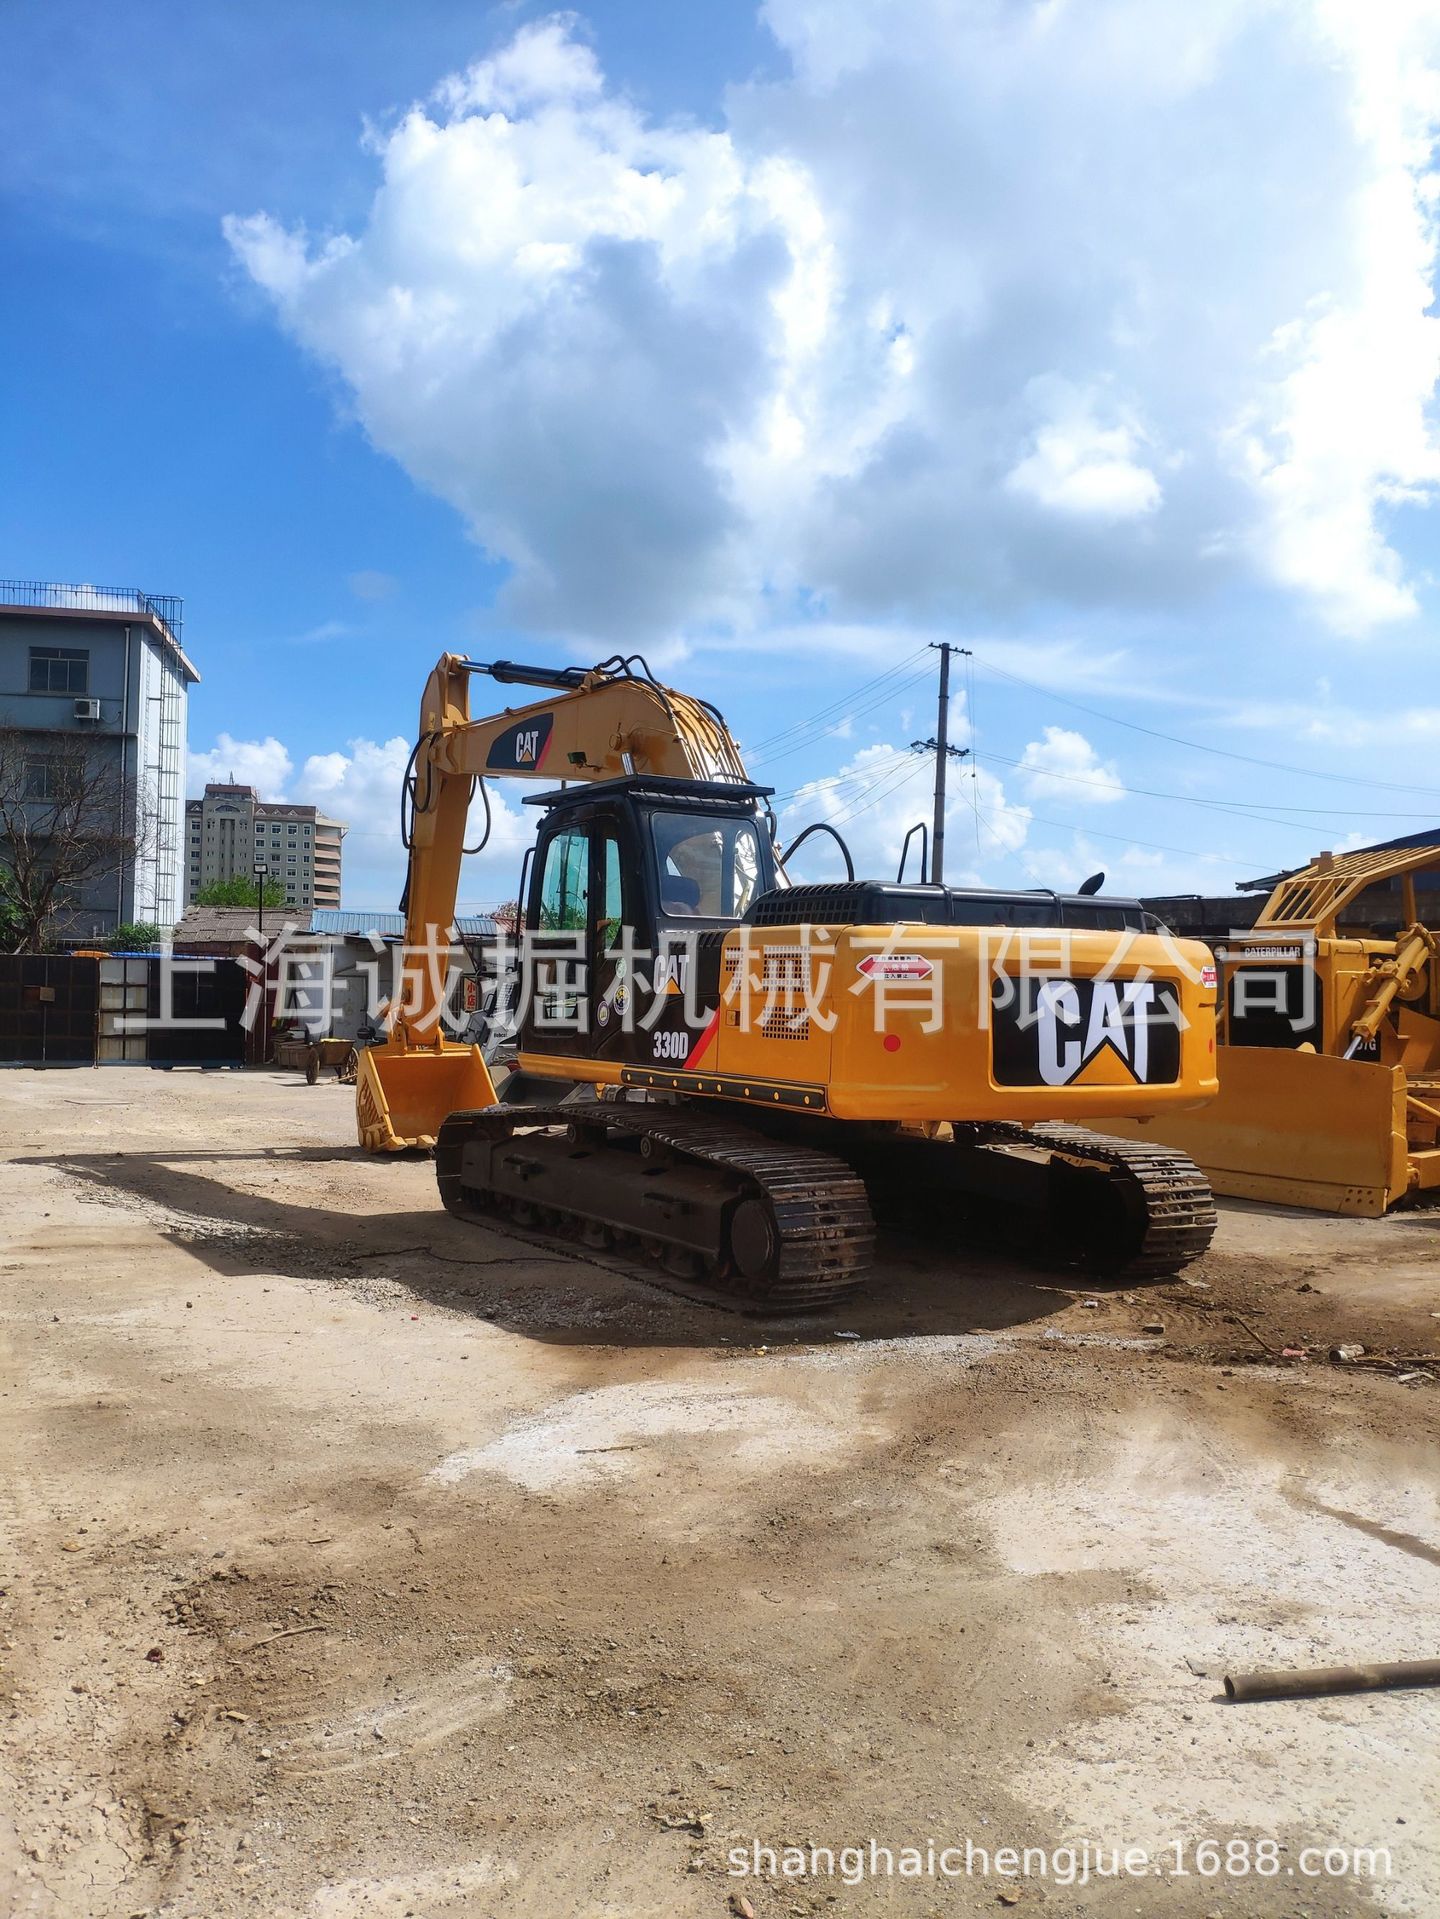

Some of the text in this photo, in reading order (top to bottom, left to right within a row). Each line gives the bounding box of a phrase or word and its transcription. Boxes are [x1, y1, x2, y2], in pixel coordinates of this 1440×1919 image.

[516, 731, 539, 763] CAT
[1244, 946, 1301, 958] CATERPILLAR
[653, 954, 690, 995] CAT
[653, 1031, 689, 1059] 330D
[1036, 980, 1155, 1086] CAT
